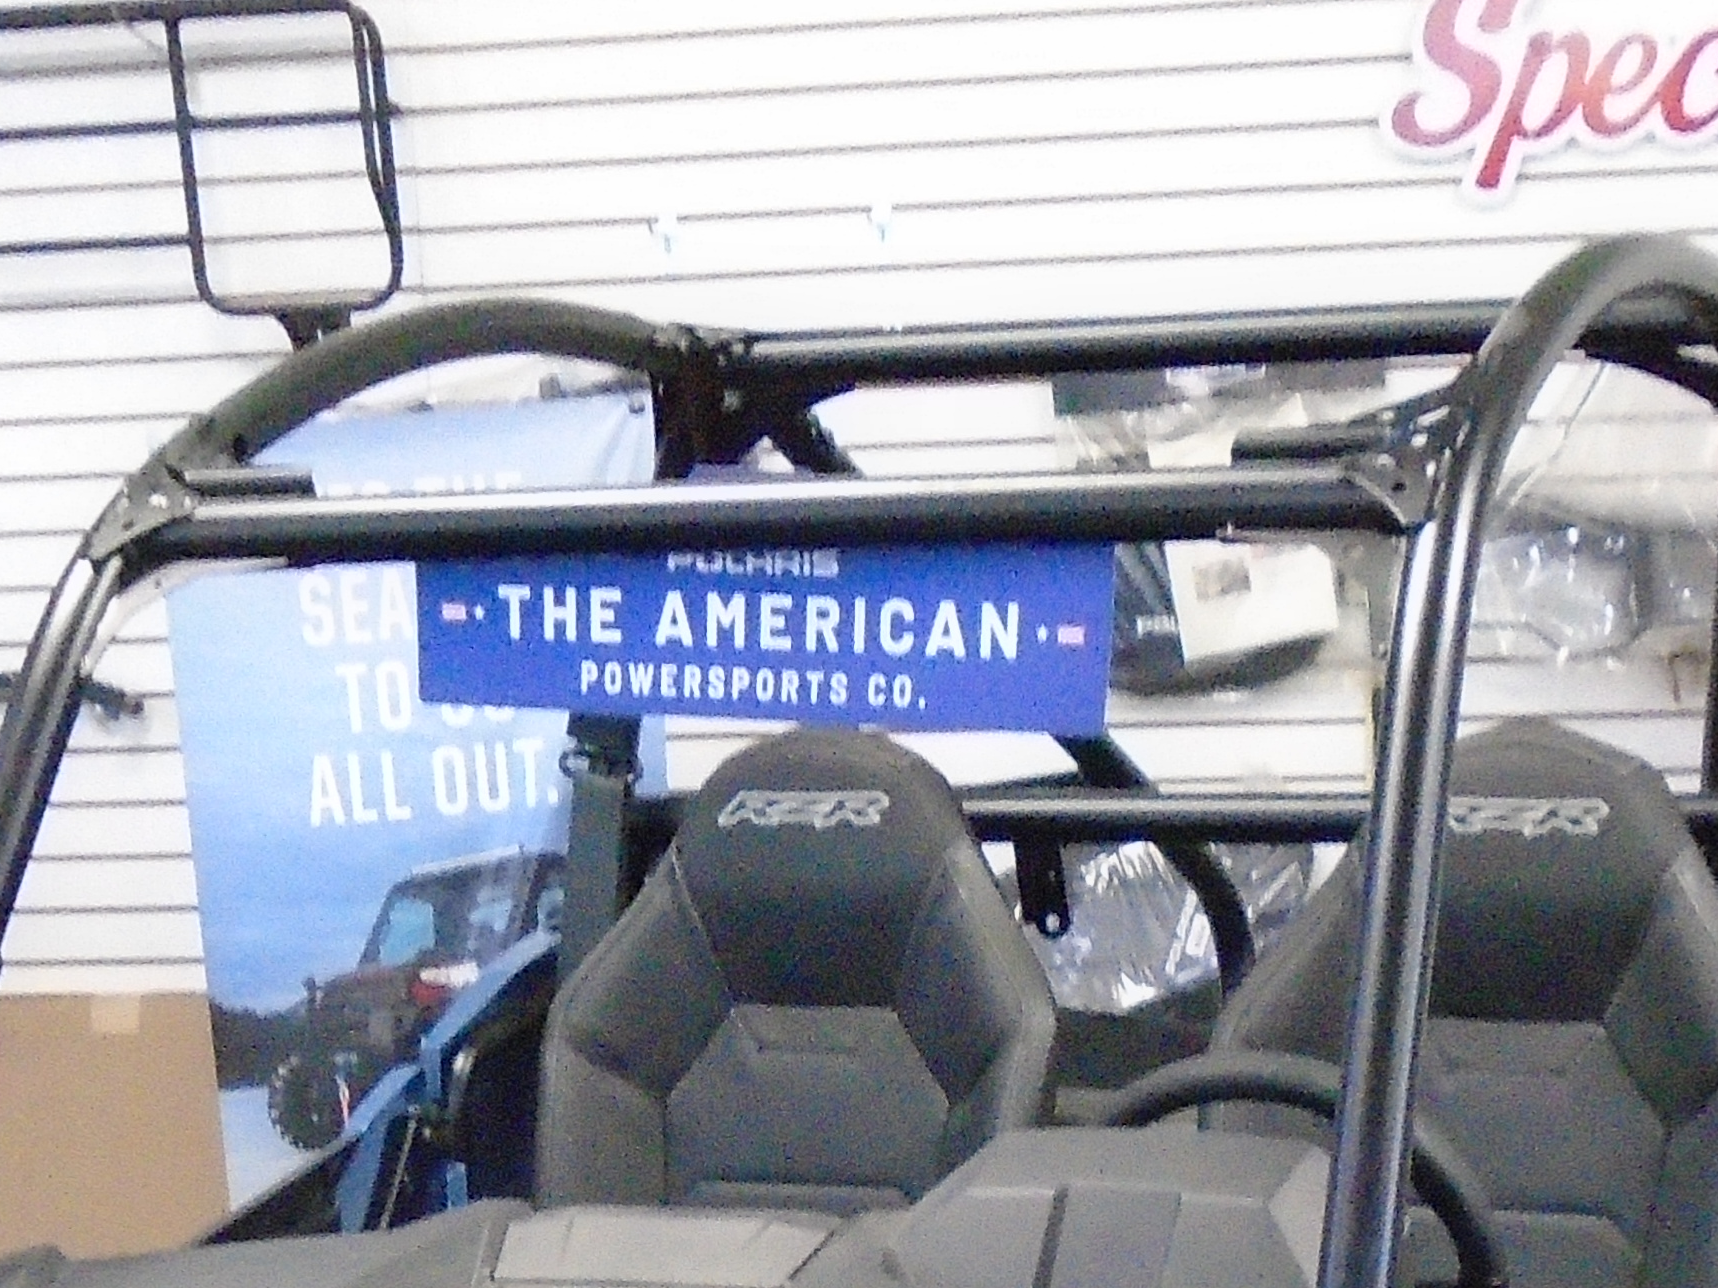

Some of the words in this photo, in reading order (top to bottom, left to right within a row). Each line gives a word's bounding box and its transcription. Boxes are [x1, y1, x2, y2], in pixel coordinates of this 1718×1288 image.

[297, 568, 416, 647] SEA
[497, 583, 623, 645] THE
[654, 589, 1021, 661] AMERICAN
[334, 660, 413, 734] TO
[580, 659, 849, 706] POWERSPORTS
[867, 671, 927, 710] CO.
[310, 748, 413, 827] ALL
[433, 737, 560, 818] OUT.
